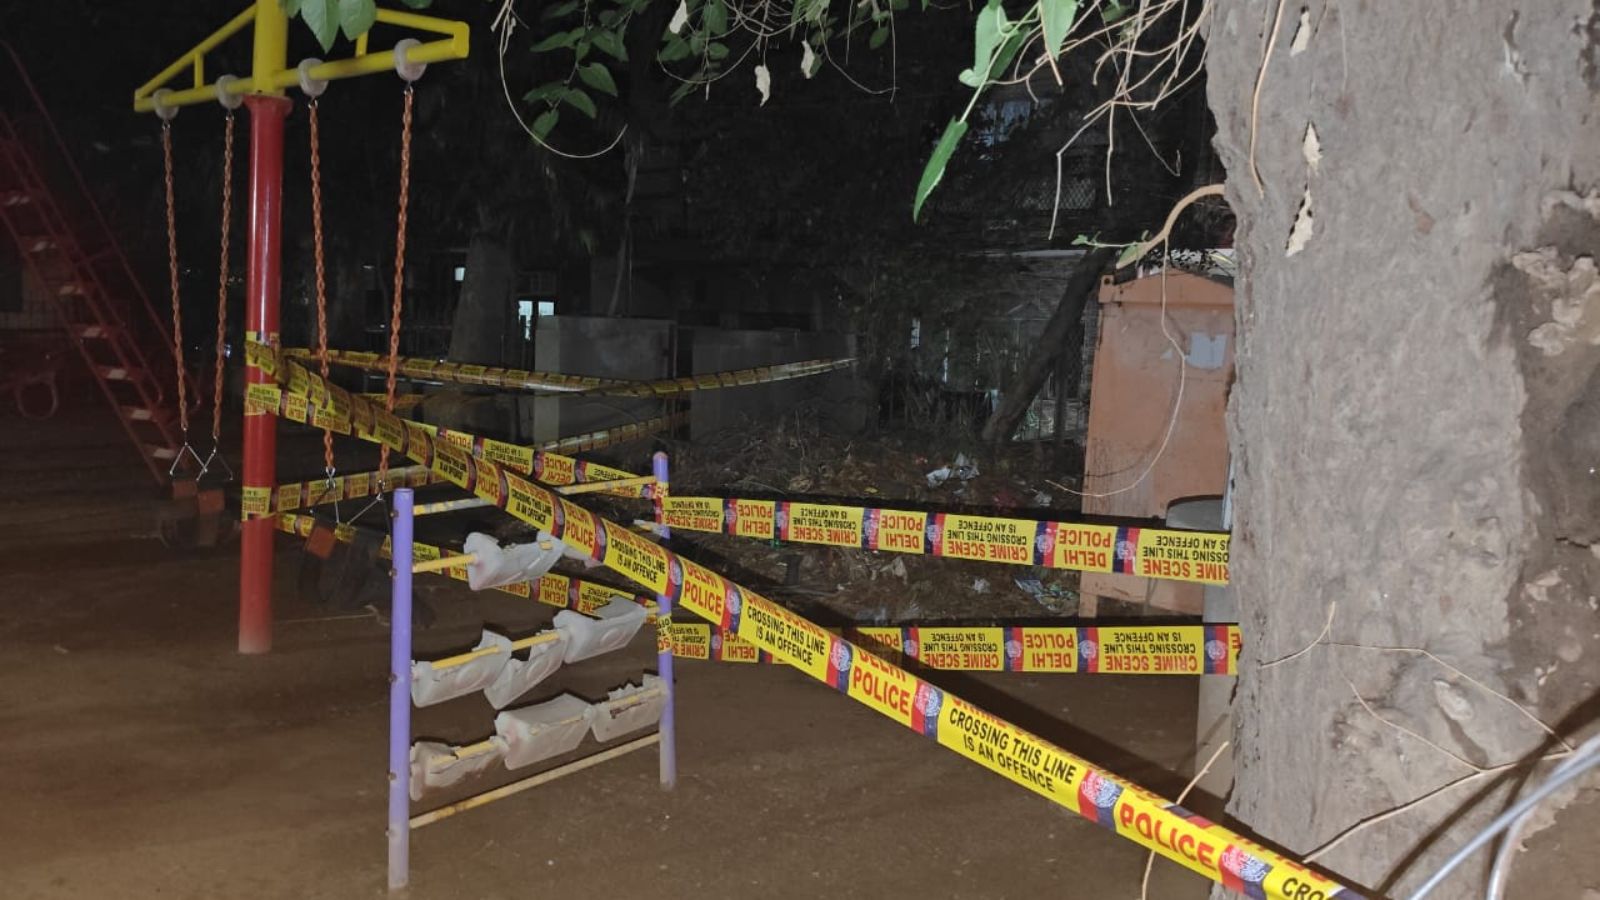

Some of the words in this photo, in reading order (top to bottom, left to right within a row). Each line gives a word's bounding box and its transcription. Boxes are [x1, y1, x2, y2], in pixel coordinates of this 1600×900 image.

[738, 504, 773, 519] POLICE
[800, 508, 830, 519] OFFENCE
[831, 509, 840, 518] AN
[841, 510, 847, 519] IS
[743, 519, 770, 534] DELHI
[809, 517, 822, 527] THIS
[824, 519, 857, 530] CROSSING
[881, 515, 923, 532] POLICE
[958, 519, 993, 532] OFFENCE
[994, 521, 1006, 532] AN
[1009, 523, 1016, 533] IS
[565, 523, 594, 549] POLICE
[793, 526, 826, 541] SCENE
[828, 531, 857, 545] CRIME
[947, 529, 964, 540] LINE
[967, 530, 984, 542] THIS
[986, 532, 1027, 546] CROSSING
[1059, 529, 1111, 548] POLICE
[886, 533, 920, 549] DELHI
[1156, 535, 1200, 549] OFFENCE
[1203, 538, 1216, 549] AN
[948, 540, 986, 558] SCENE
[990, 544, 1028, 561] CRIME
[1143, 546, 1164, 558] LINE
[1168, 548, 1189, 560] THIS
[611, 538, 637, 560] CROSSING
[639, 550, 652, 567] THIS
[653, 557, 666, 575] LINE
[1063, 549, 1106, 568] DELHI
[1192, 550, 1230, 563] OSSING
[632, 562, 657, 584] OFFENCE
[1143, 559, 1191, 578] SCENE
[1195, 562, 1230, 581] RIME
[684, 580, 722, 617] POLICE
[747, 606, 785, 635] CROSSING
[787, 625, 805, 645] THIS
[806, 633, 826, 656] LINE
[931, 632, 963, 642] OFFENCE
[965, 633, 976, 642] AN
[978, 633, 986, 642] IS
[1113, 632, 1152, 642] OFFENCE
[1154, 632, 1171, 642] AN
[1174, 632, 1182, 642] IS
[756, 626, 763, 640] IS
[765, 632, 776, 646] AN
[777, 637, 813, 666] OFFENCE
[924, 642, 939, 652] LINE
[942, 643, 957, 652] THIS
[959, 643, 997, 653] CROSSING
[1024, 633, 1074, 649] POLICE
[728, 645, 756, 659] DELHI
[1104, 643, 1125, 654] LINE
[1126, 643, 1148, 654] THIS
[1150, 643, 1197, 654] CROSSING
[925, 653, 960, 668] SCENE
[963, 653, 1000, 668] CRIME
[1031, 653, 1071, 669] DELHI
[1105, 655, 1150, 671] SCENE
[1153, 655, 1198, 671] CRIME
[852, 666, 911, 717] POLICE
[950, 707, 1009, 750] CROSSING
[1012, 739, 1042, 766] THIS
[1044, 753, 1077, 785] LINE
[963, 734, 975, 752] IS
[978, 744, 995, 762] AN
[998, 752, 1056, 794] OFFENCE
[1119, 802, 1219, 873] POLICE
